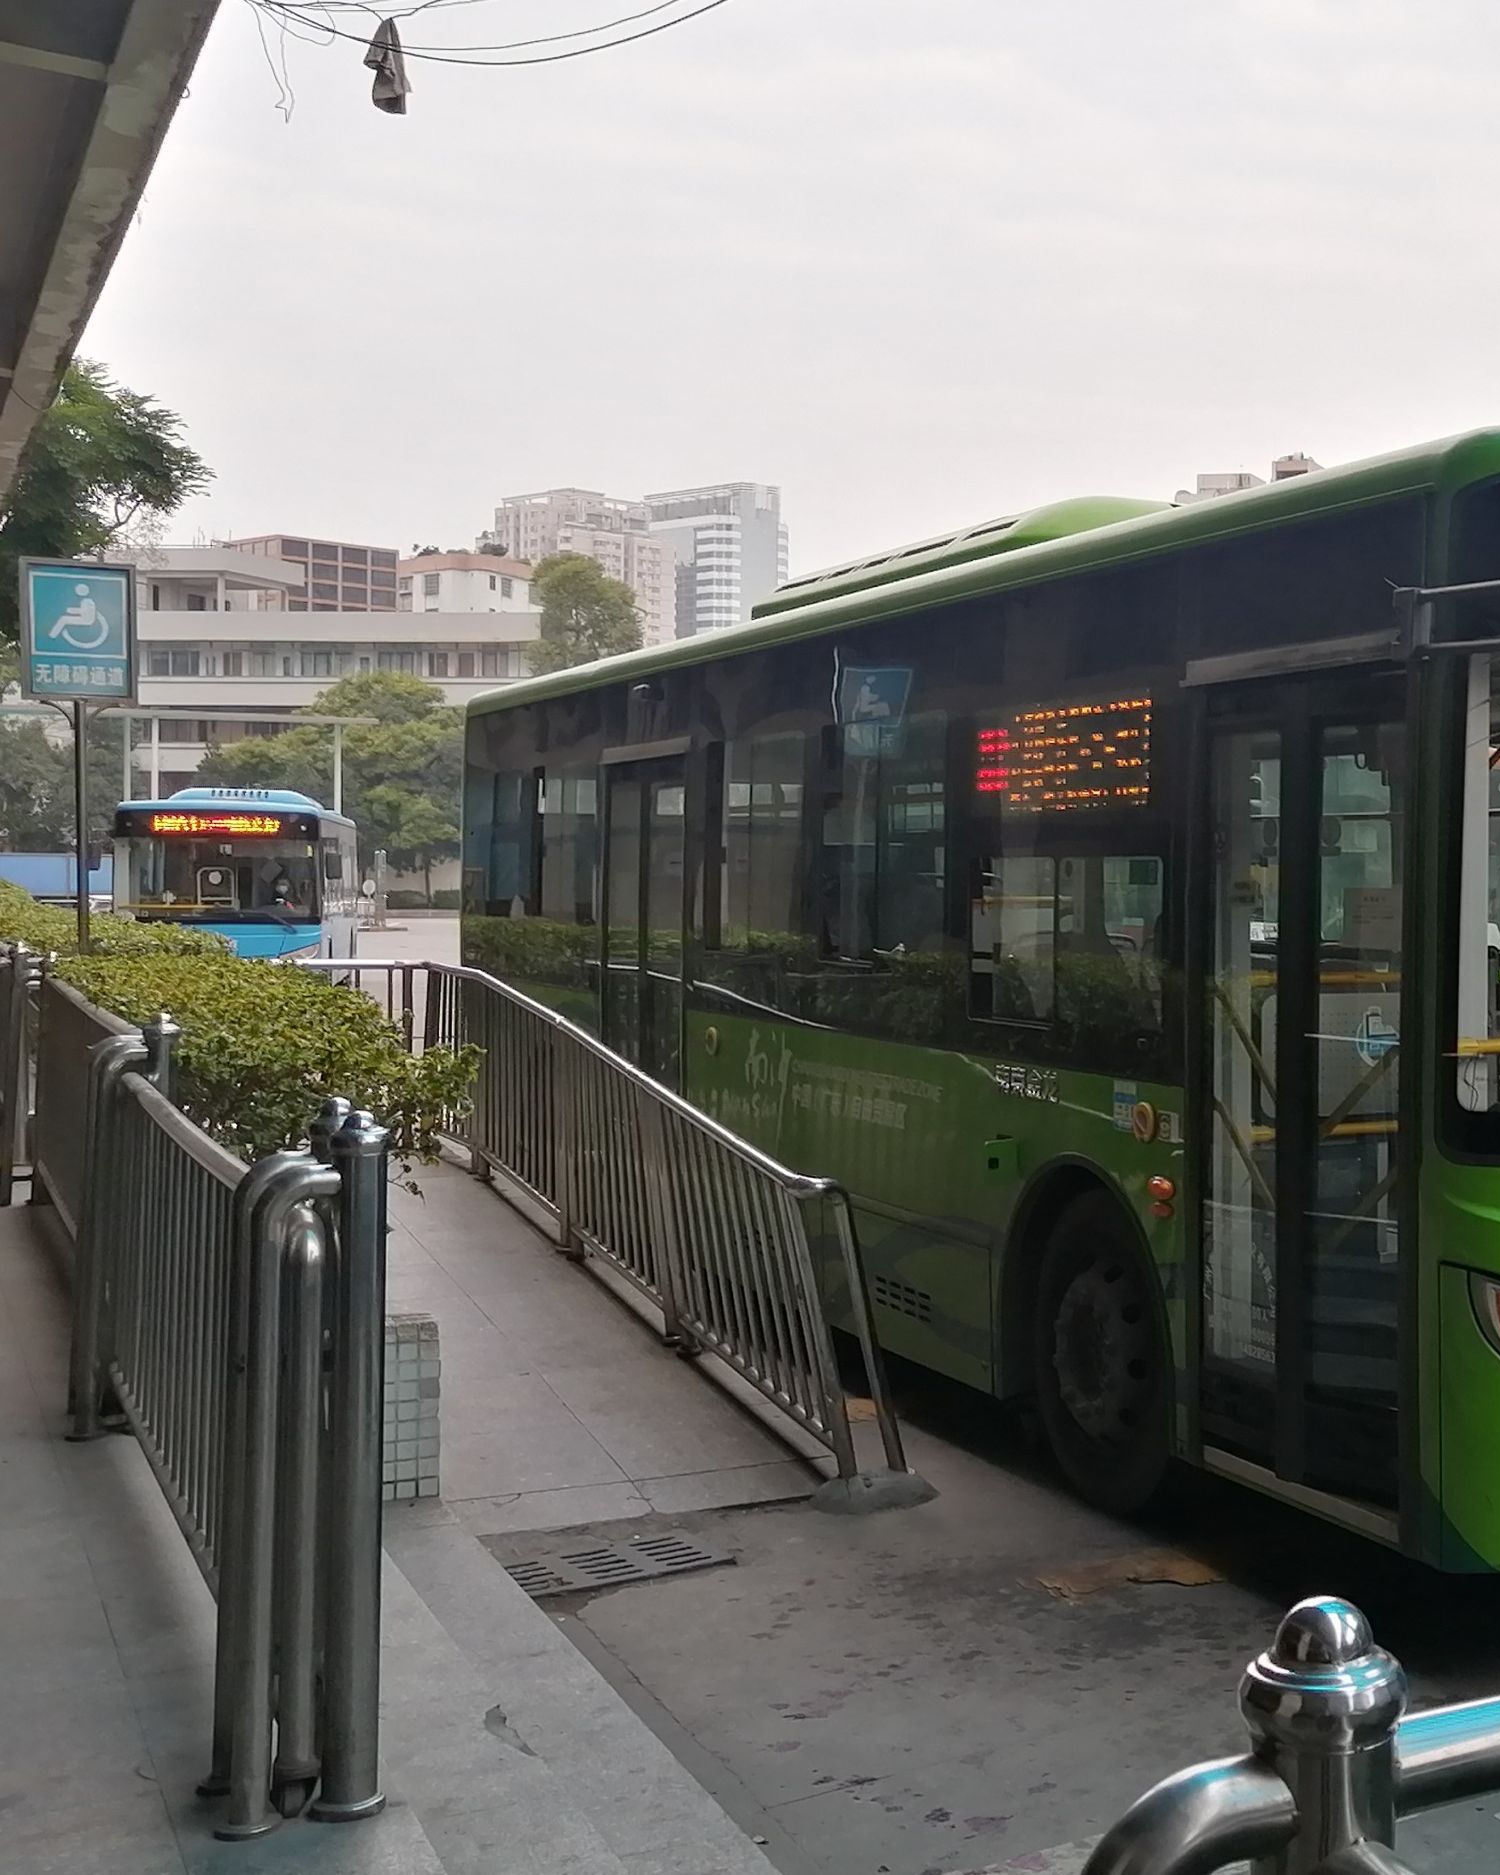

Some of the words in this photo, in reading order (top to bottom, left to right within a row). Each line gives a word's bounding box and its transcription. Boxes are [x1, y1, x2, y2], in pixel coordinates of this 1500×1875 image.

[35, 663, 124, 687] 无障碍通道
